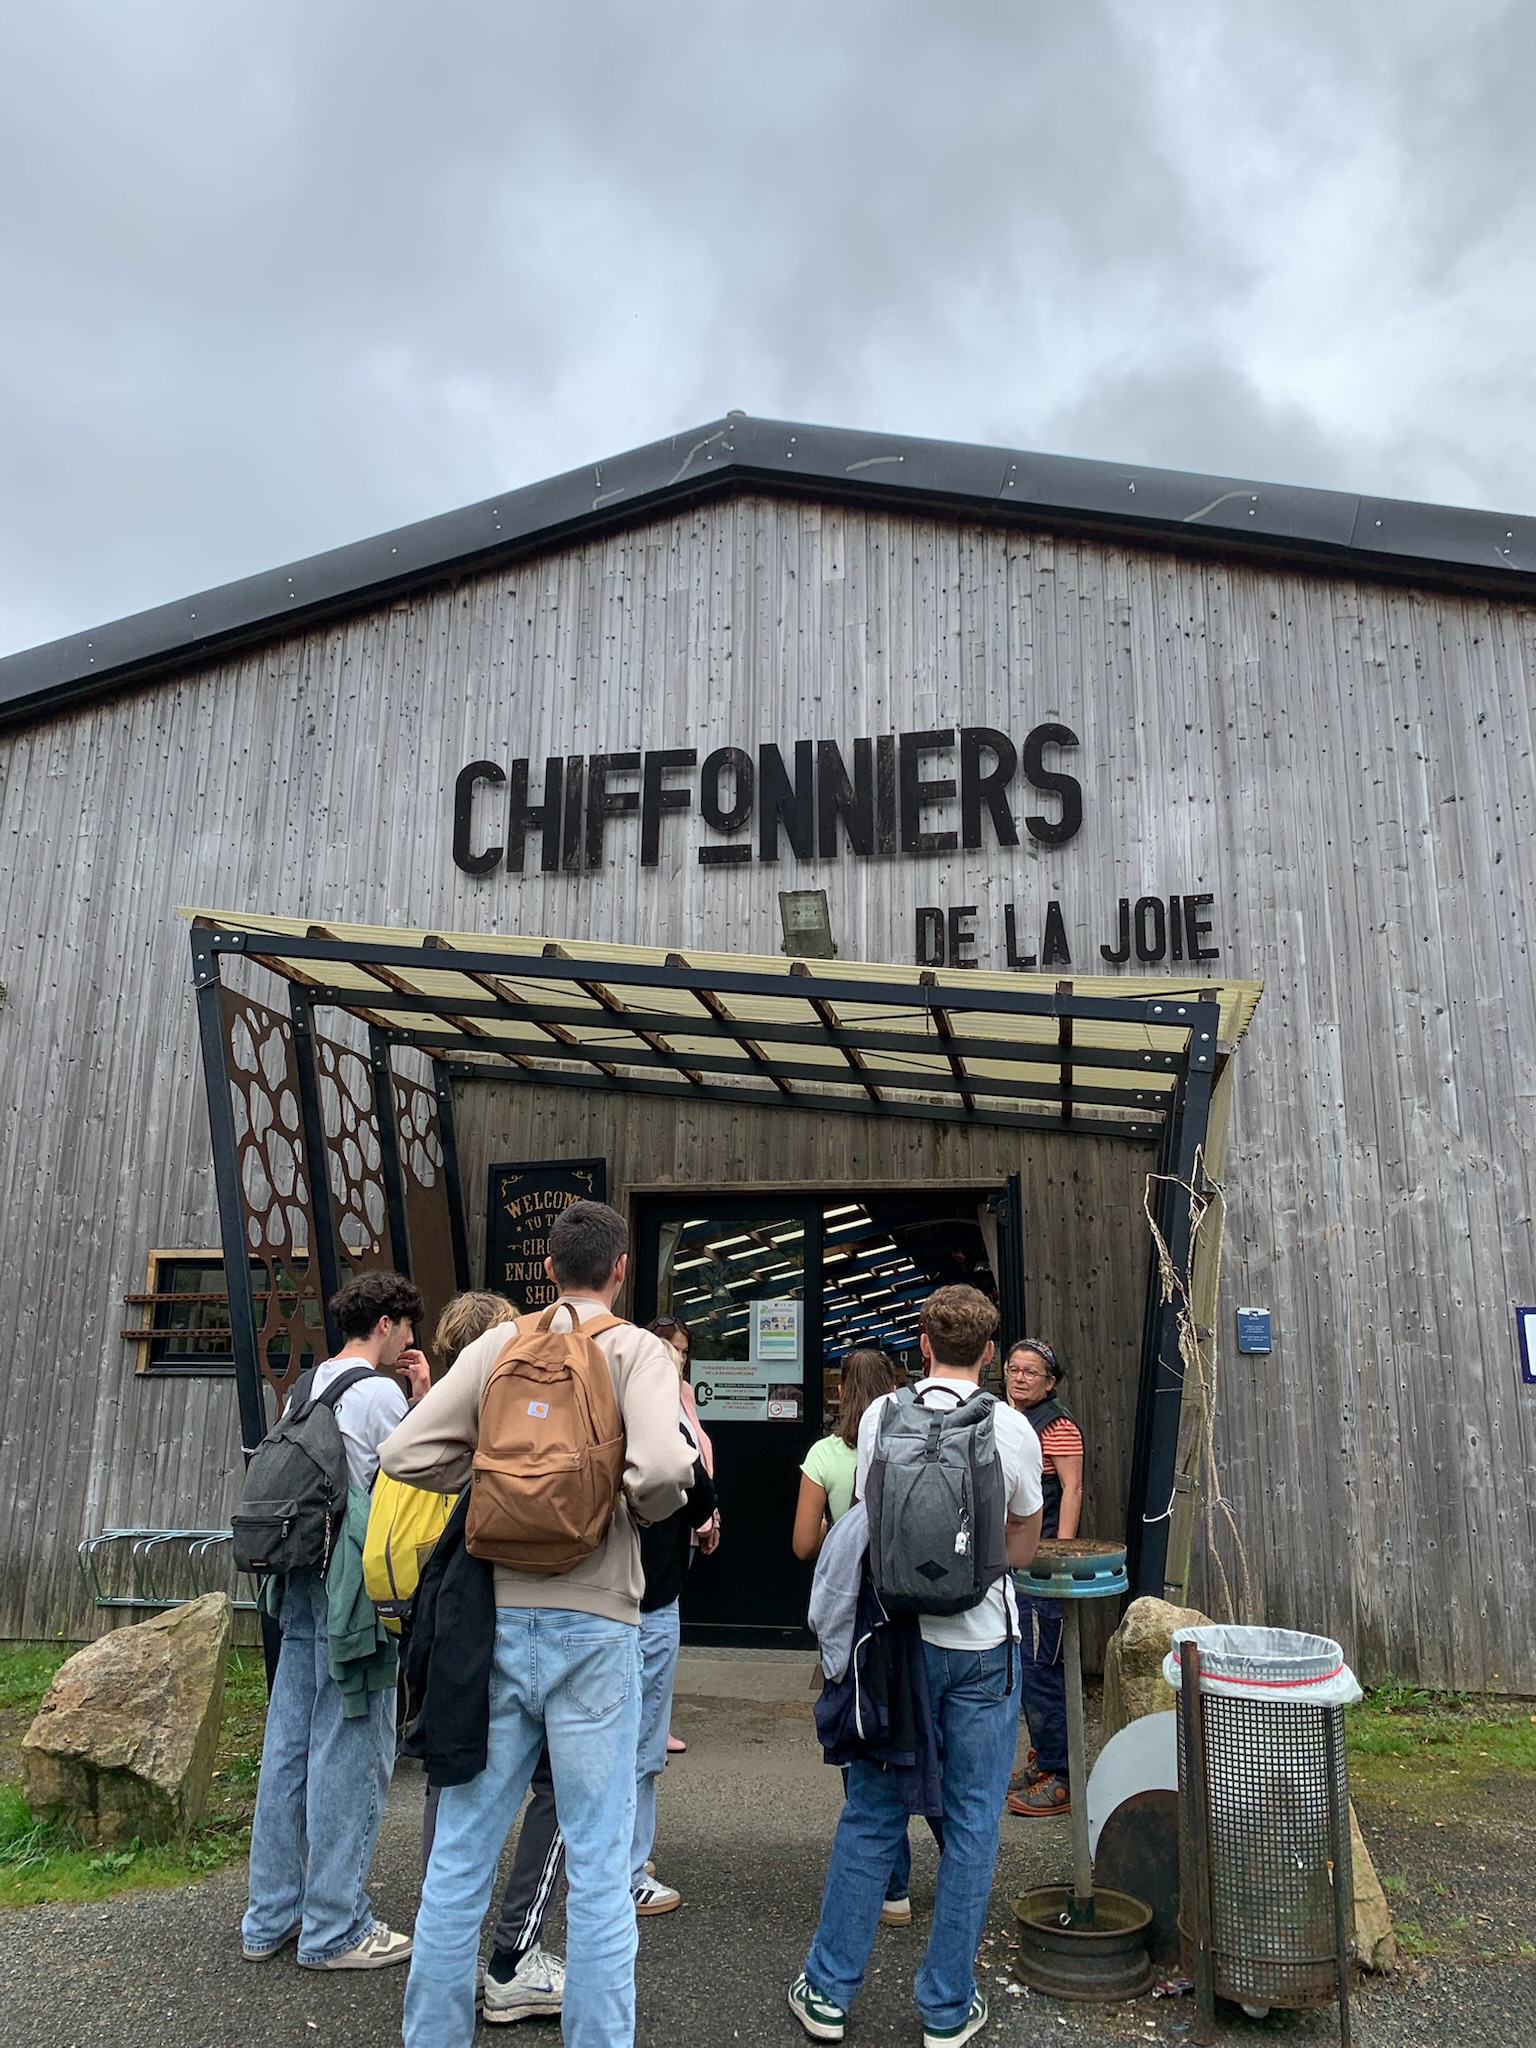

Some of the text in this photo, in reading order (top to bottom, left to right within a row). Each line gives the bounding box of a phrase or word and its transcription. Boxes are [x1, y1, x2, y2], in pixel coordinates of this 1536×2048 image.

[453, 723, 1083, 875] CHIFFONNIERS
[915, 893, 1219, 969] DE LA JOIE
[503, 1190, 587, 1219] WELCOM
[525, 1215, 542, 1231] TO
[525, 1284, 560, 1304] SHO
